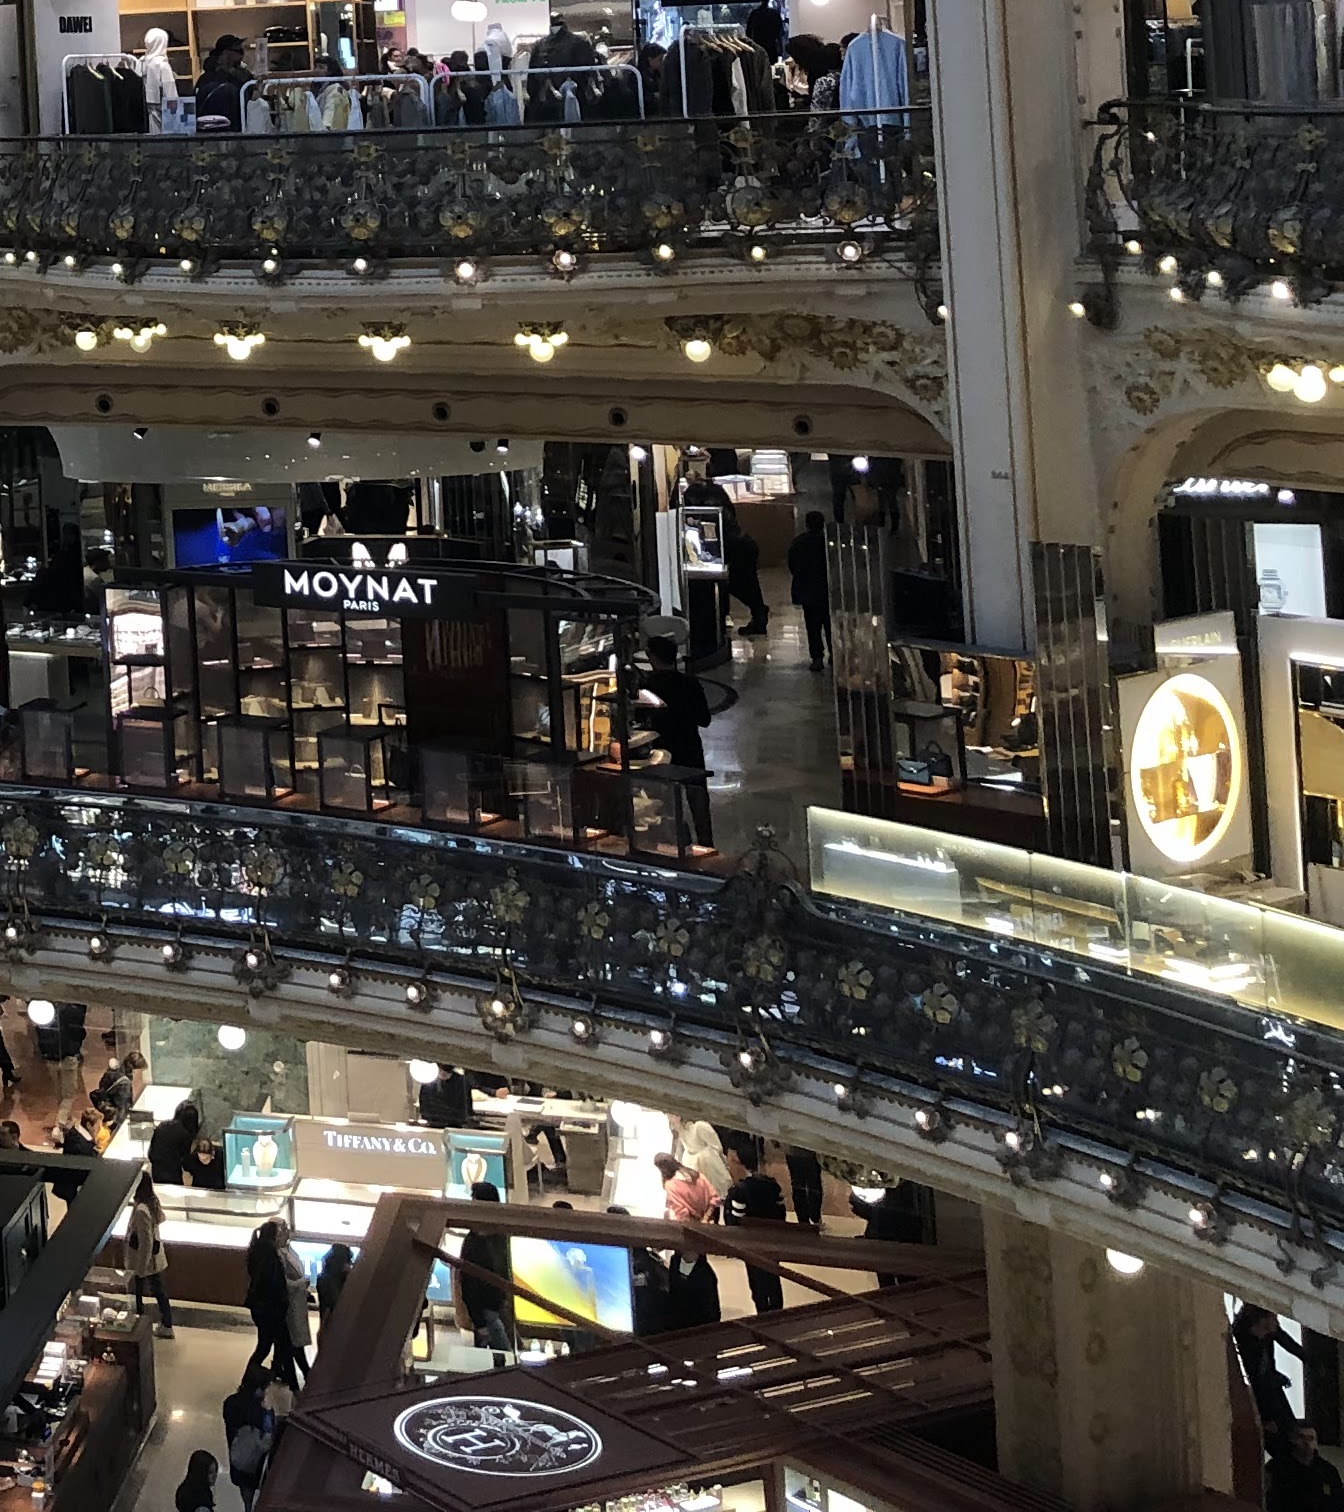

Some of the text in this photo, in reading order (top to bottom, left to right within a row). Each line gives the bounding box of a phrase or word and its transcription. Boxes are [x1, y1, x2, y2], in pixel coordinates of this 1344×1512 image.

[59, 15, 93, 34] DAWEI
[283, 568, 438, 605] MOYNAT
[343, 599, 380, 612] PARIS
